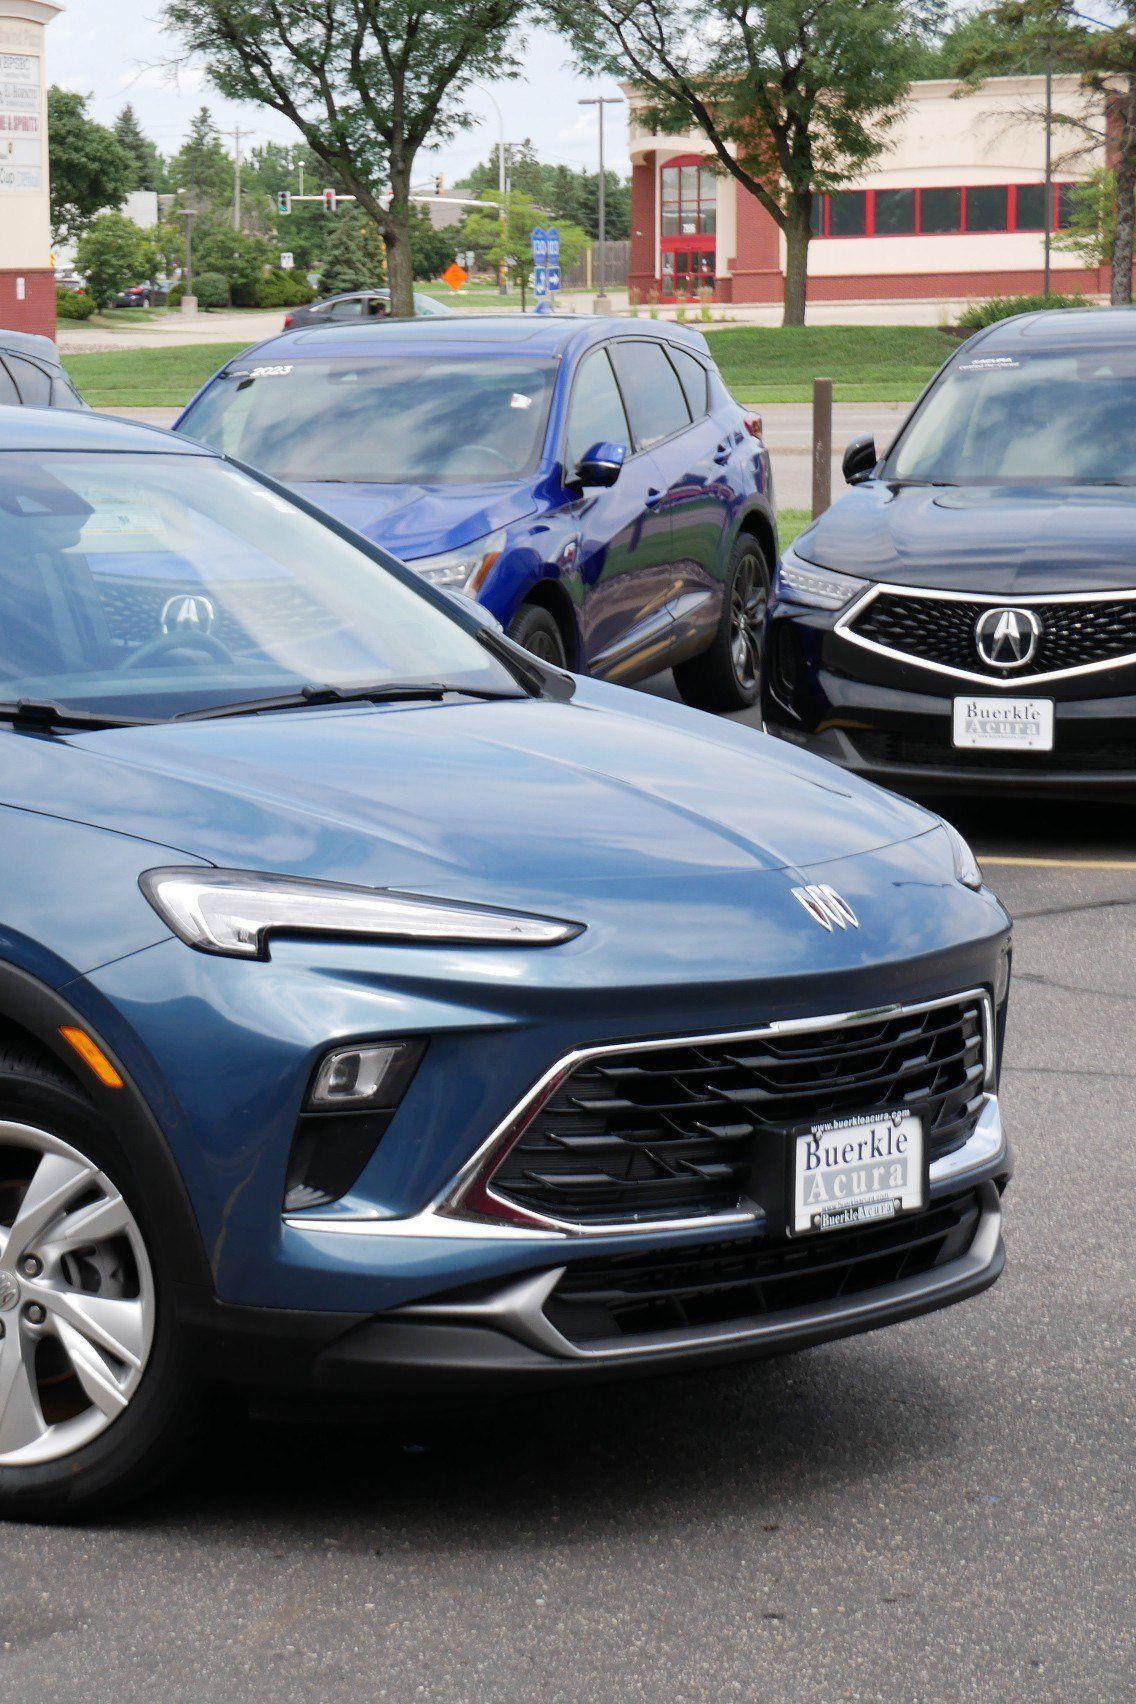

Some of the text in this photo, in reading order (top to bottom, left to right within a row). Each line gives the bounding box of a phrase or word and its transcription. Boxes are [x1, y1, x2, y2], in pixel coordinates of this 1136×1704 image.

[965, 703, 1041, 720] Buerkle
[968, 720, 1037, 736] Acura
[810, 1108, 911, 1133] www.buerkleacura.com
[805, 1126, 908, 1171] Buerkle
[807, 1162, 904, 1202] Acura
